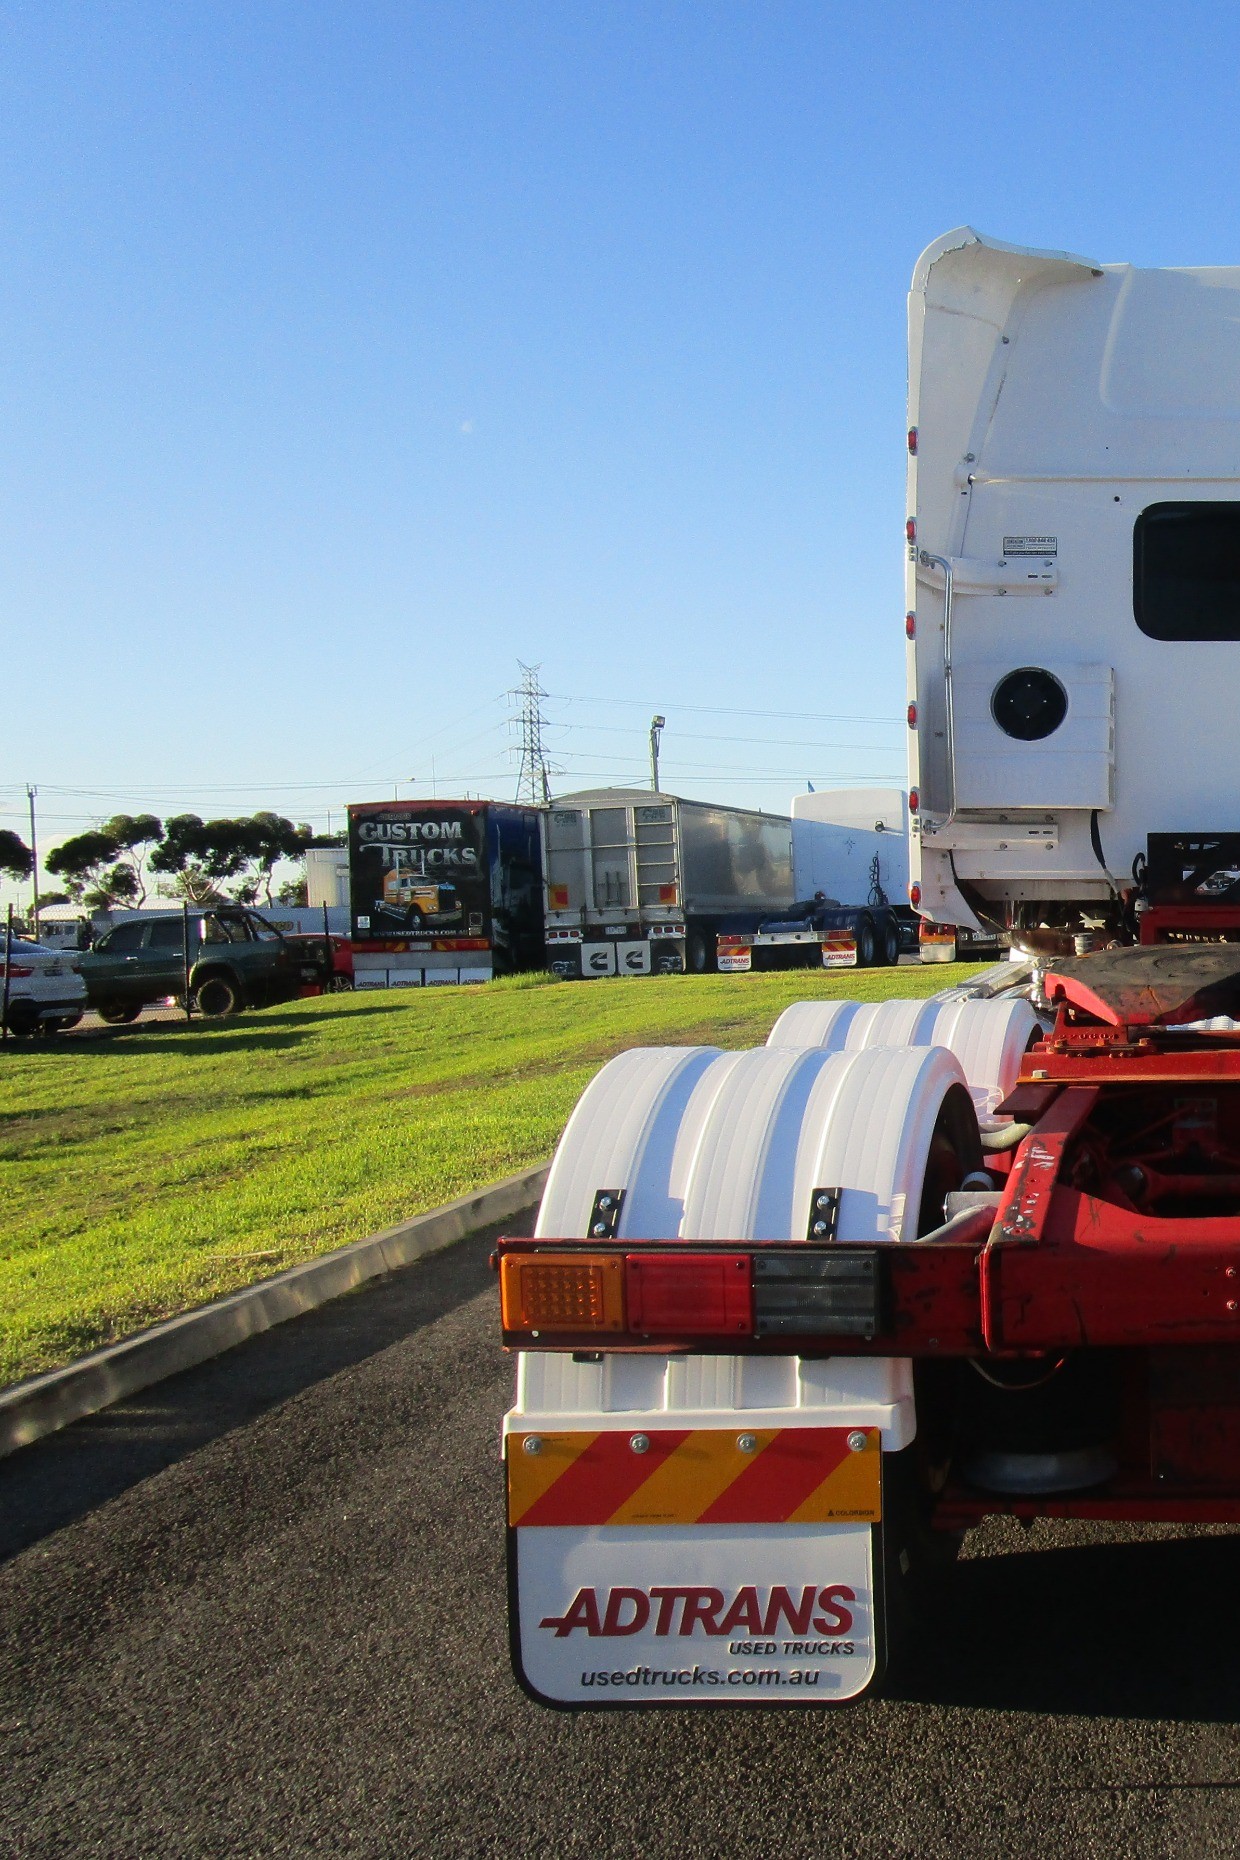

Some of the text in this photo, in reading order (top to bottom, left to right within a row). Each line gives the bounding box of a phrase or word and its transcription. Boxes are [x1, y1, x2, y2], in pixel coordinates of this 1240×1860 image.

[358, 821, 462, 841] CUSTOM
[359, 845, 477, 867] TRUCKS
[538, 1585, 855, 1637] ADTRANS
[729, 1641, 855, 1655] USED TRUCKS
[581, 1665, 820, 1687] usedtrucks.com.au
